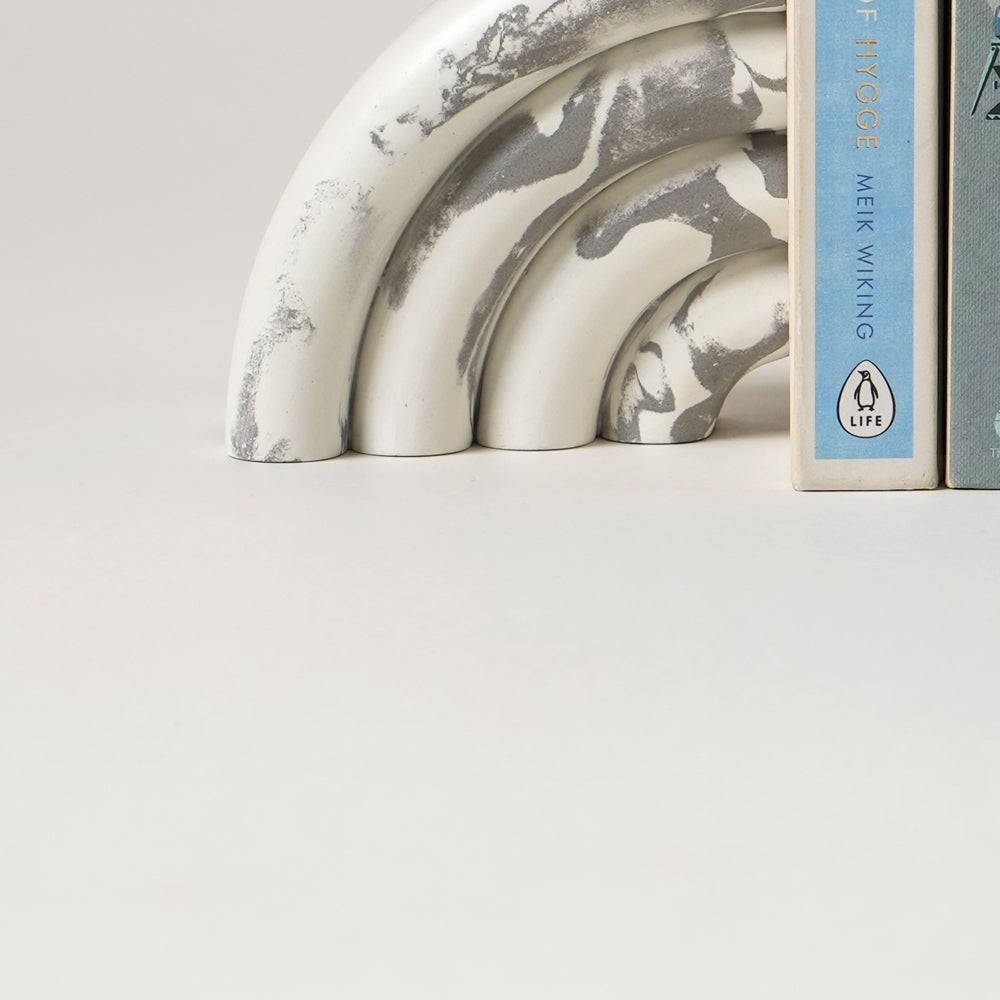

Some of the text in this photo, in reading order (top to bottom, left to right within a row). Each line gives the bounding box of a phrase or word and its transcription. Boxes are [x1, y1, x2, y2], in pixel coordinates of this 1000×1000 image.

[855, 36, 880, 149] HYGGE
[856, 174, 874, 340] MEIK WIKING
[850, 415, 882, 427] LIFE
